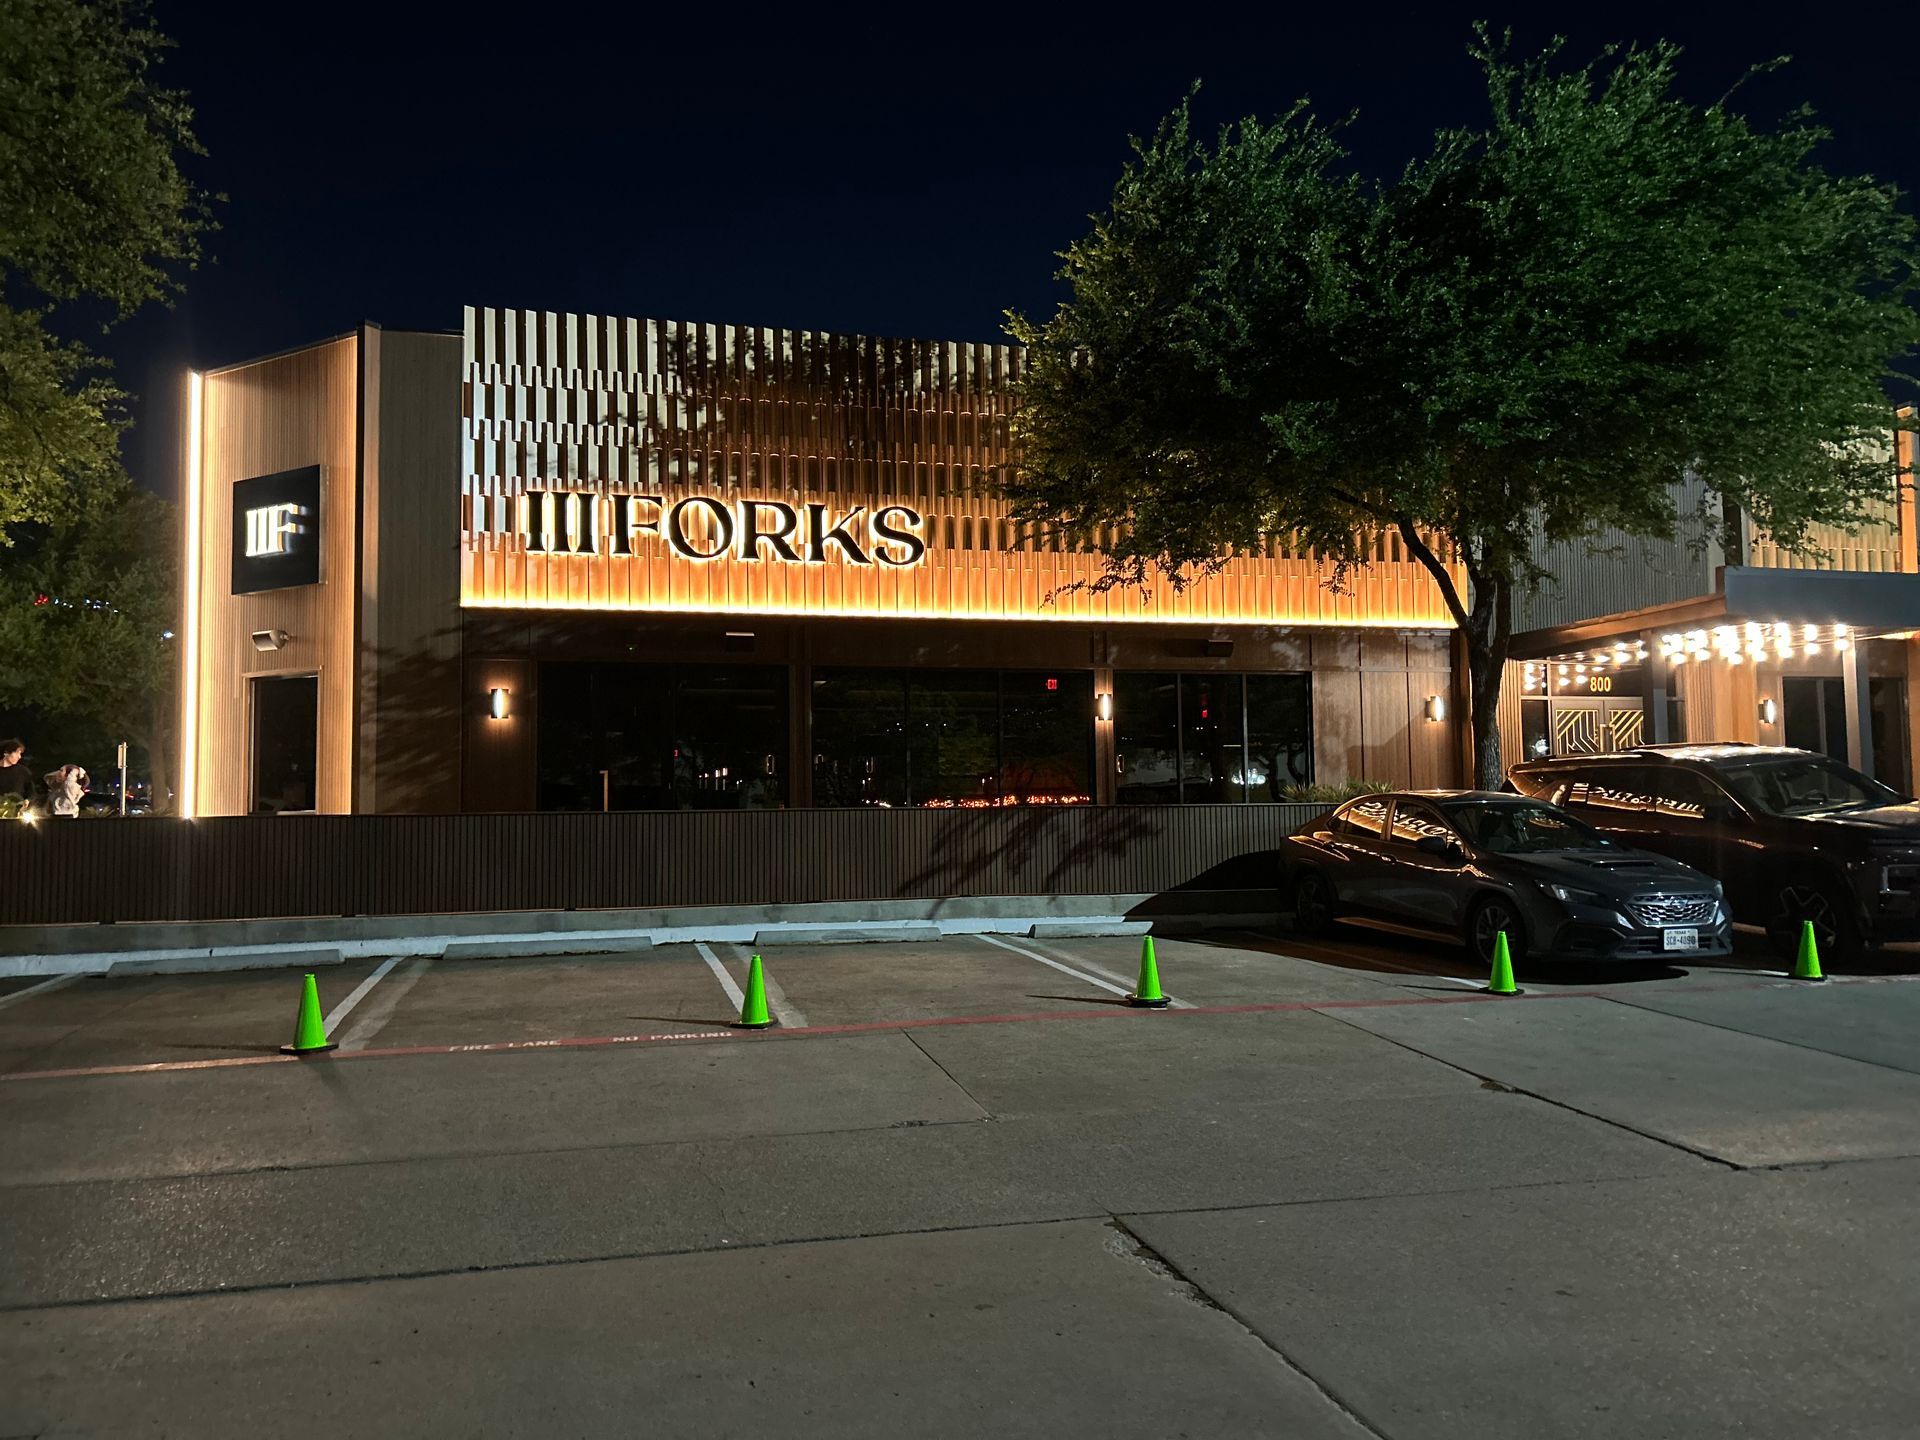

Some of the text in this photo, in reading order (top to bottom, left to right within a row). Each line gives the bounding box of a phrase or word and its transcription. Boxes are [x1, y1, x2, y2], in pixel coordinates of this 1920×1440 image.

[1590, 676, 1611, 692] 800
[449, 1043, 496, 1052] FIRE
[508, 1039, 561, 1048] LANE
[651, 1031, 732, 1040] PARKING
